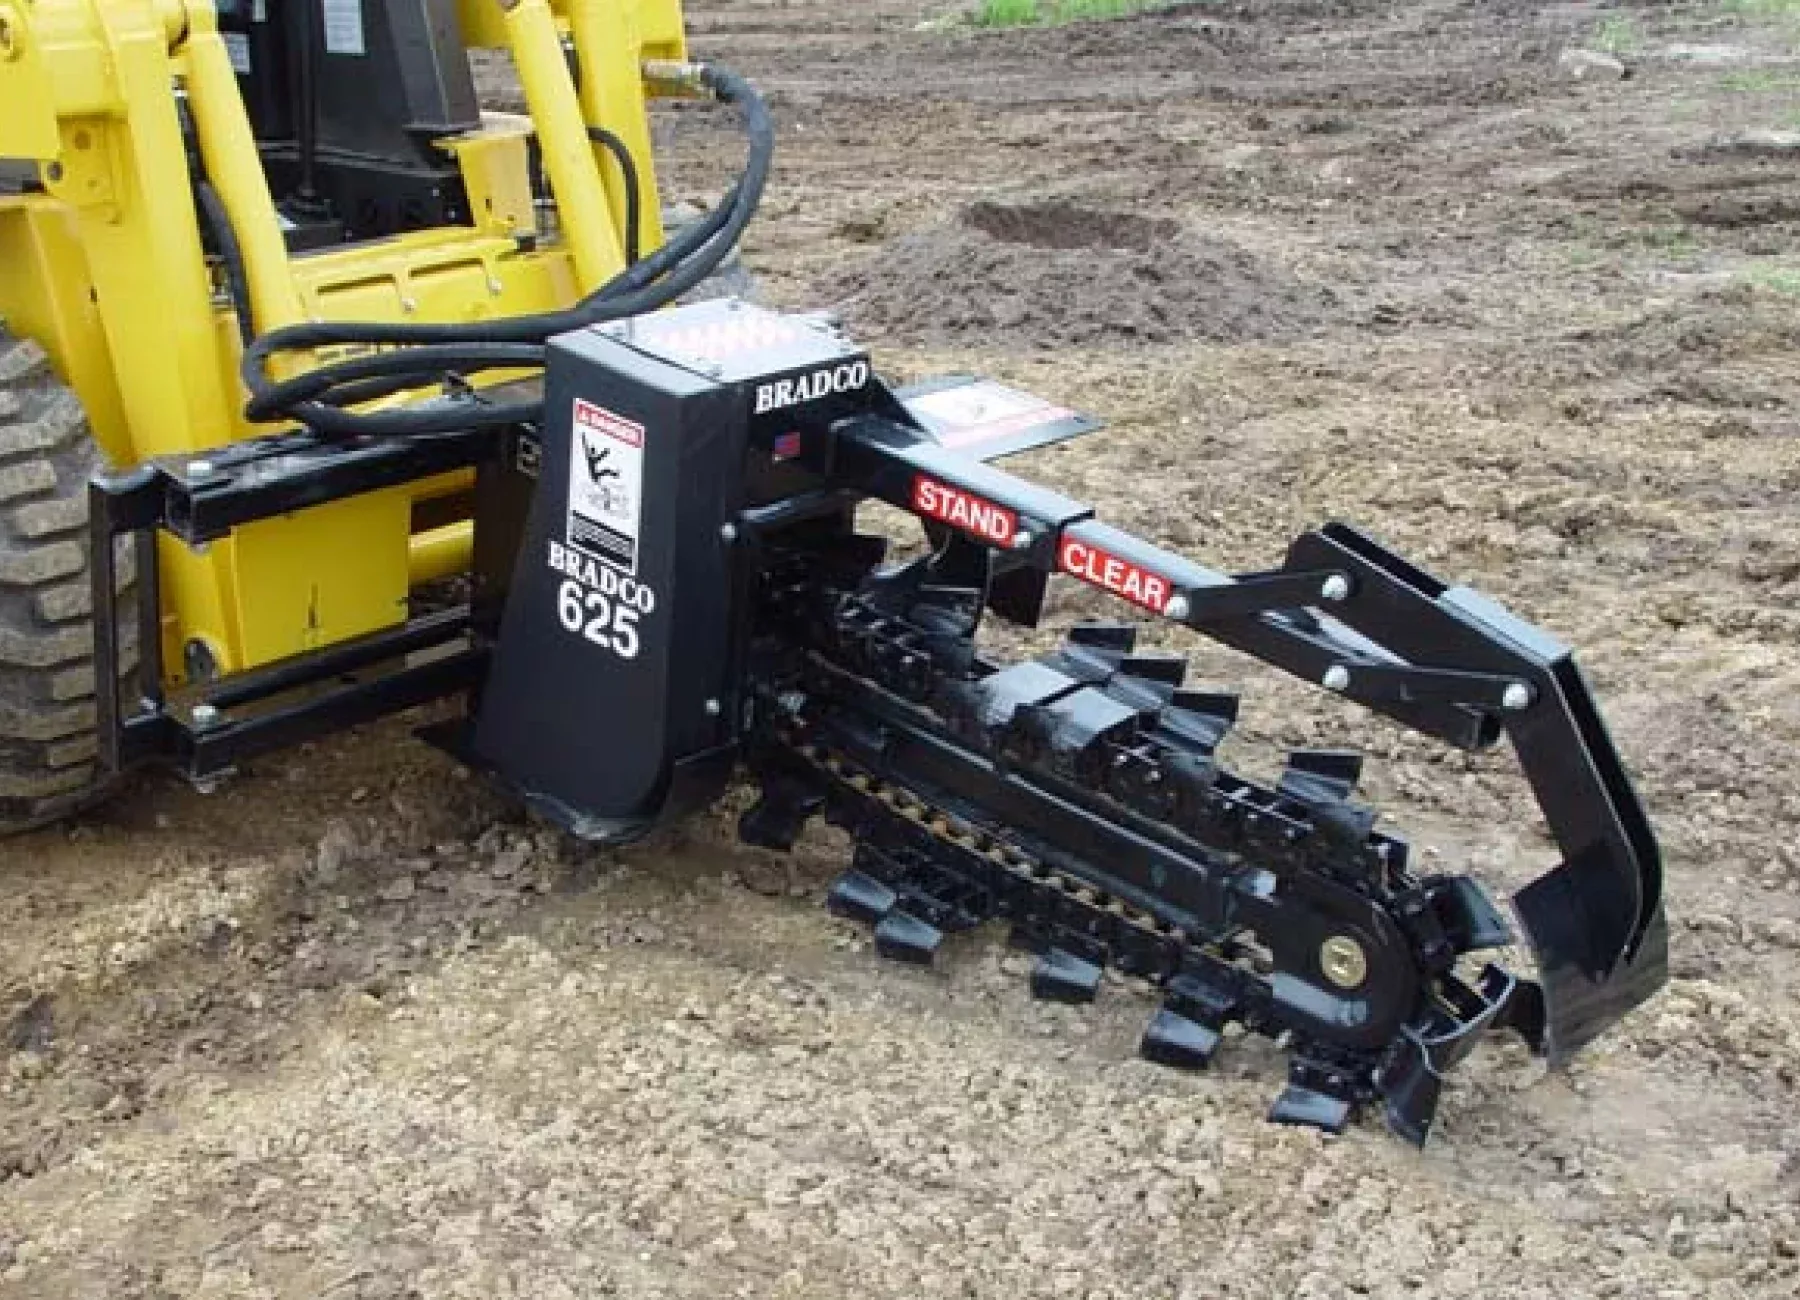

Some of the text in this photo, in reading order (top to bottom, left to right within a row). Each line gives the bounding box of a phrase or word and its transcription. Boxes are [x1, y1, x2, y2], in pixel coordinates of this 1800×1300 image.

[754, 361, 867, 413] BRADCO
[917, 481, 1009, 541] STAND
[548, 540, 655, 613] BRADCO
[1063, 543, 1165, 610] CLEAR
[558, 580, 639, 659] 625
